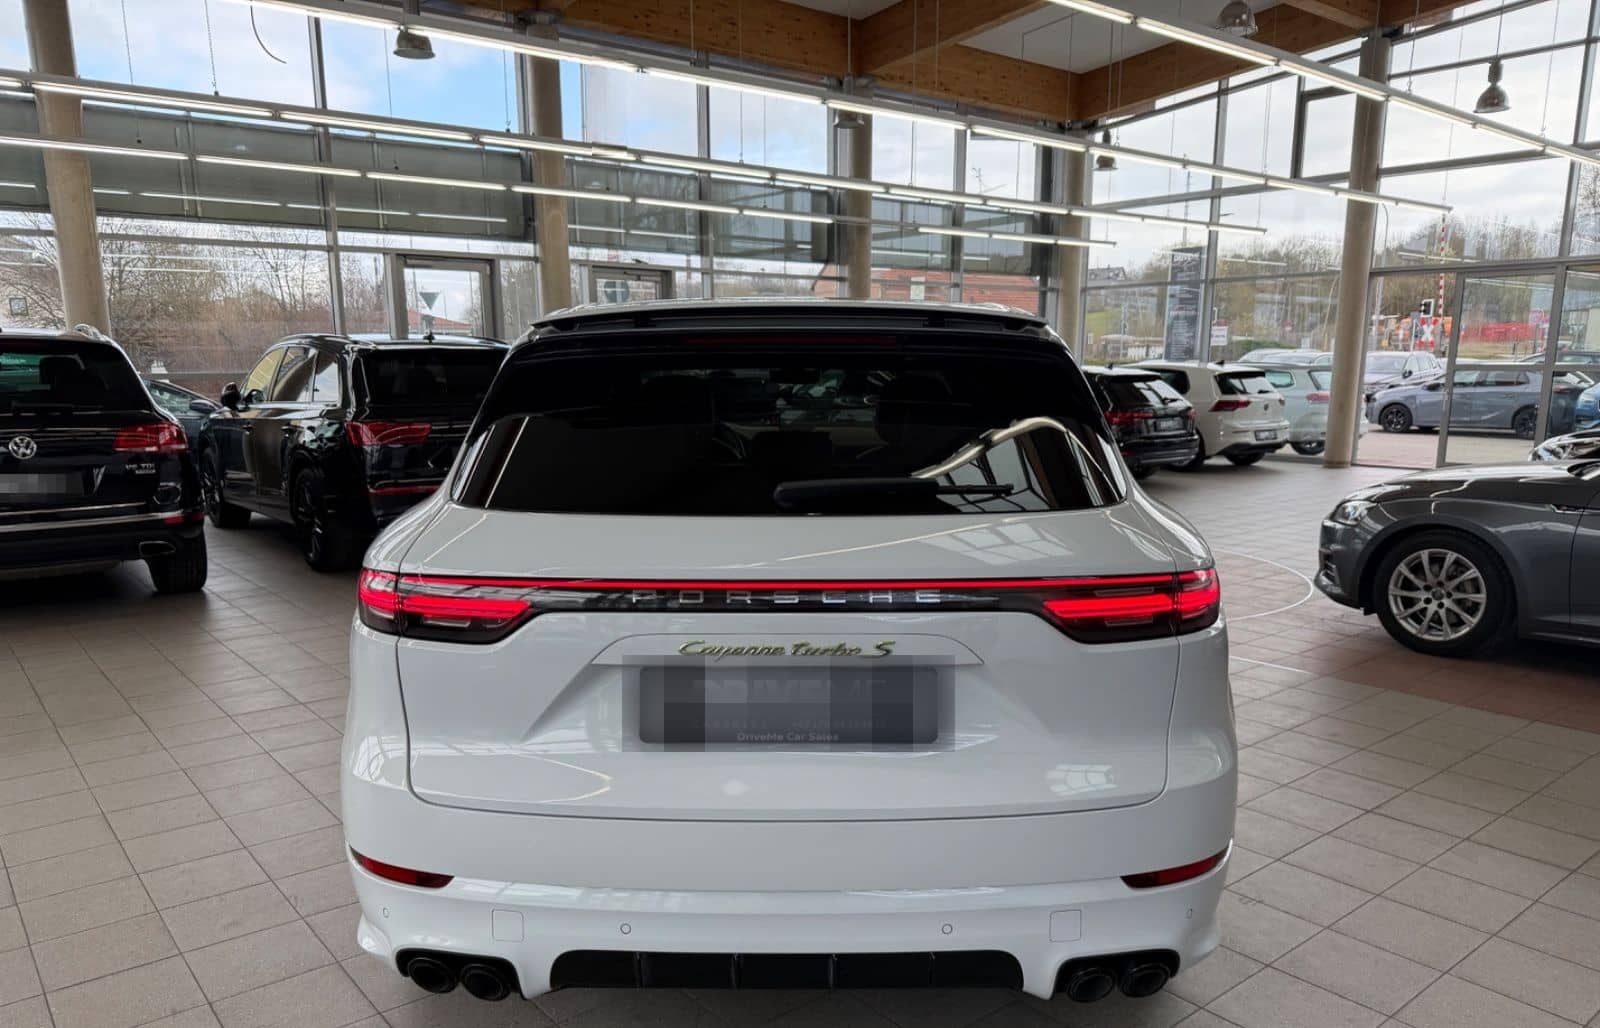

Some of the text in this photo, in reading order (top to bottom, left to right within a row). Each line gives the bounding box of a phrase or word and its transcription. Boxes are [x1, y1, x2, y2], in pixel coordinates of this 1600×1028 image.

[632, 590, 941, 604] PORSCHE
[678, 639, 786, 662] Cayenne
[861, 639, 896, 659] S
[736, 732, 840, 742] DriveMe Car Sales
